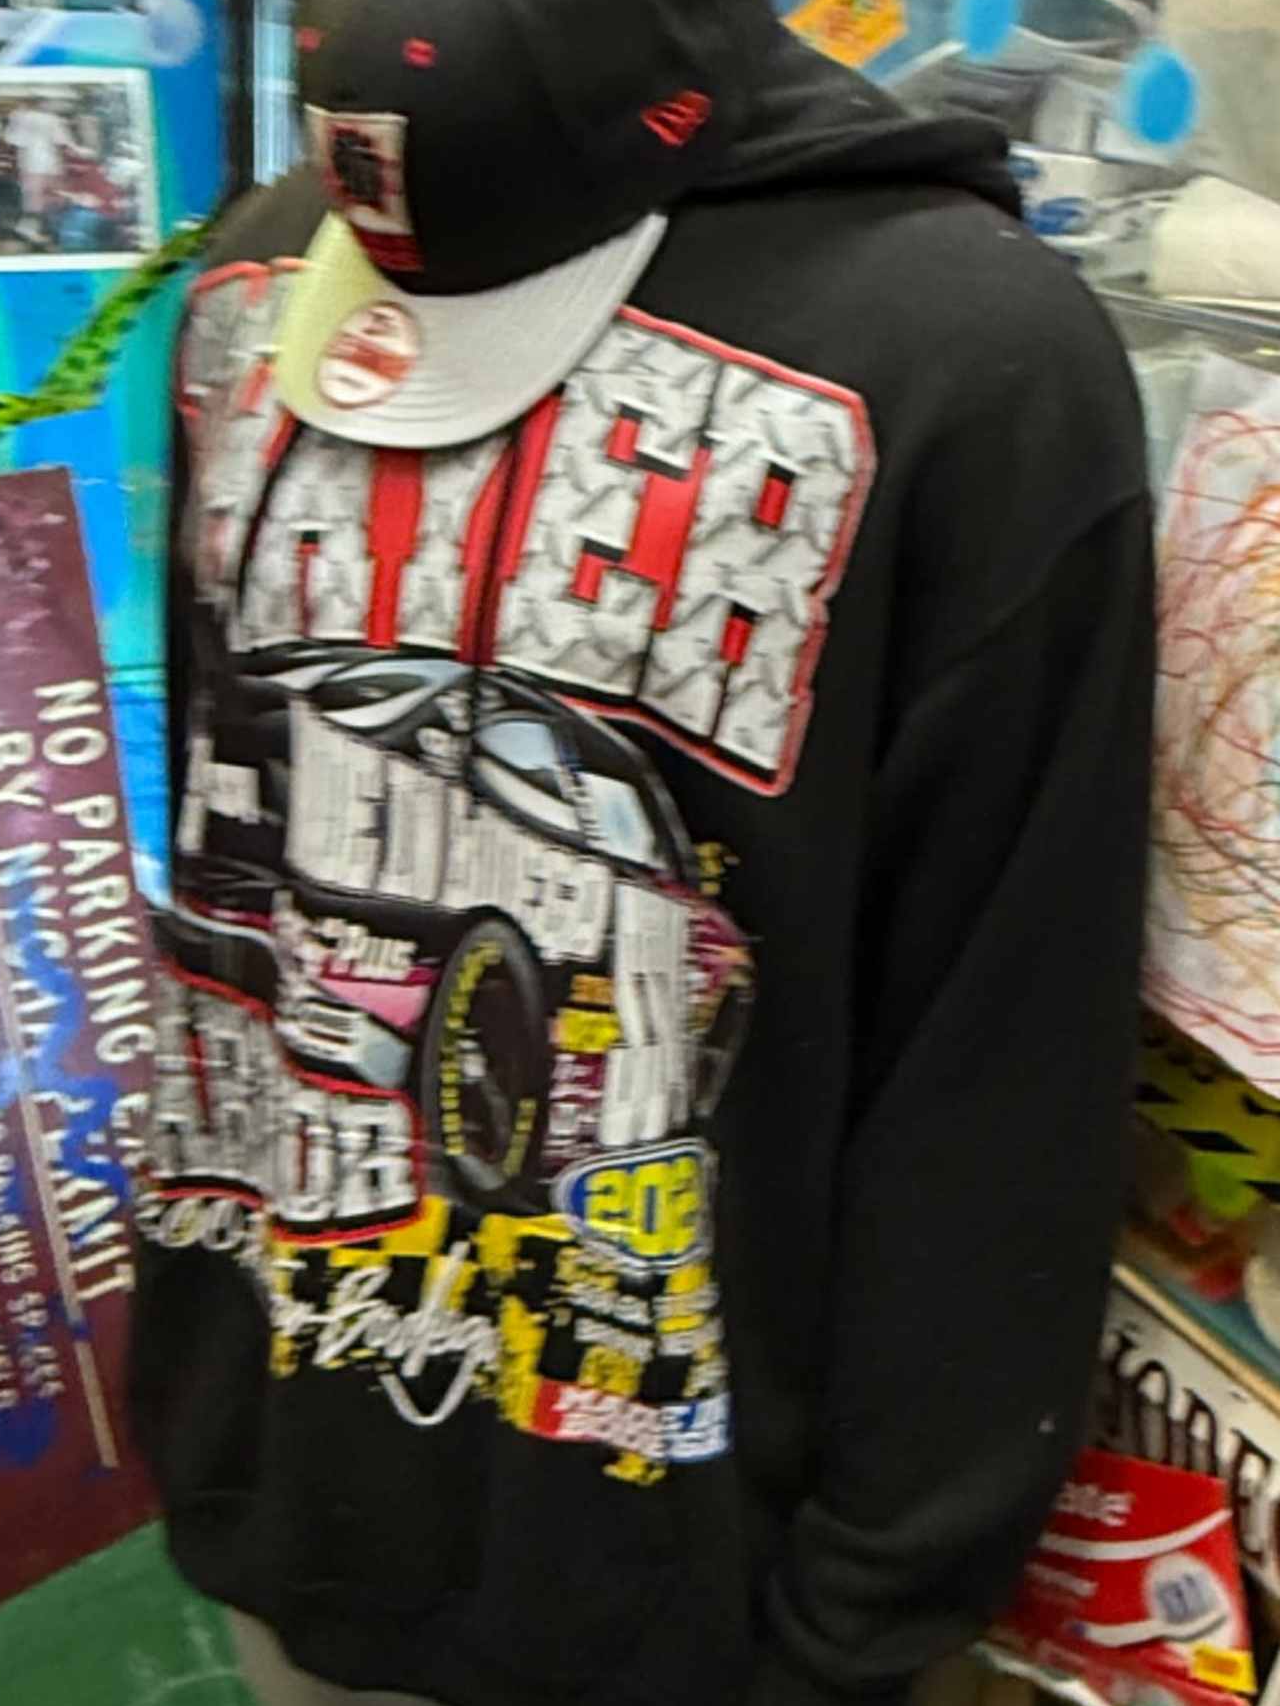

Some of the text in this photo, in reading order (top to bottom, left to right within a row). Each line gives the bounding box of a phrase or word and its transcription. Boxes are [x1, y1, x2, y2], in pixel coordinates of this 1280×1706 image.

[35, 681, 106, 762] NO
[54, 801, 153, 1063] PARKING
[8, 1291, 61, 1400] SPCES
